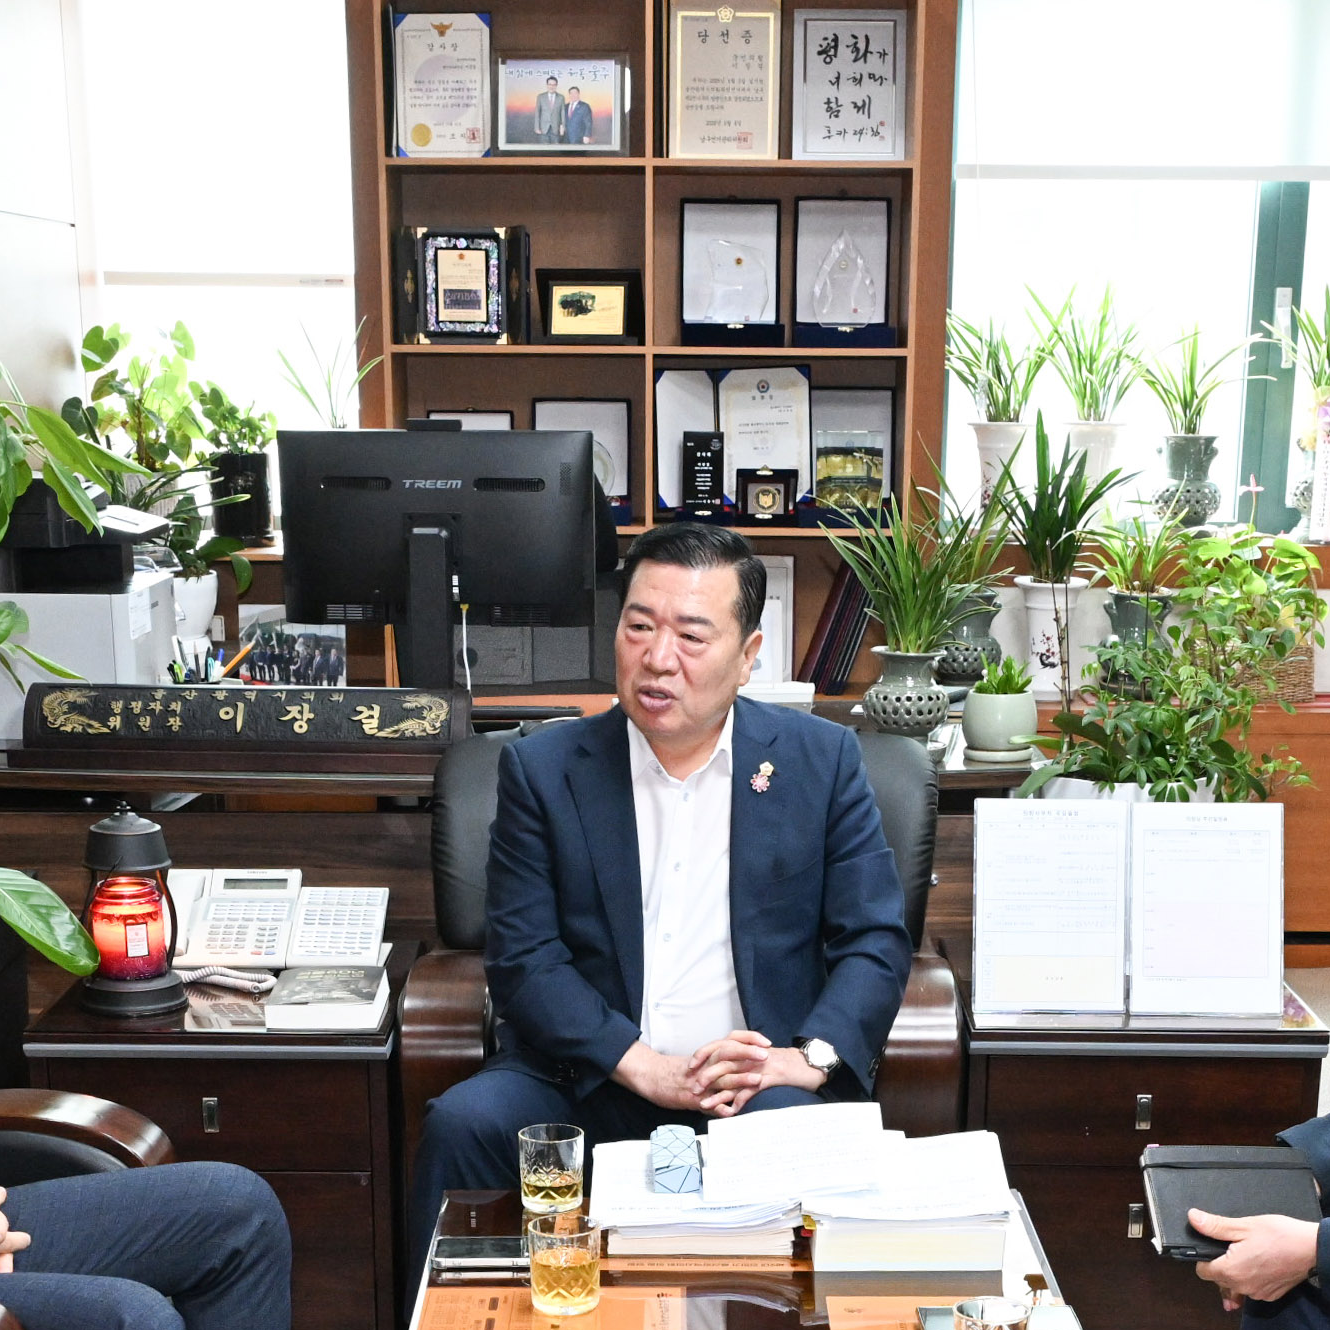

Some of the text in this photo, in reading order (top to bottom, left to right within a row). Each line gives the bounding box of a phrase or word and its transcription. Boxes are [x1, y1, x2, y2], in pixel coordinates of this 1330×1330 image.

[698, 29, 753, 45] 당선증
[402, 479, 463, 489] TREEM
[110, 701, 183, 715] 행정자치
[107, 715, 184, 732] 위원장
[218, 701, 381, 735] 이장걸
